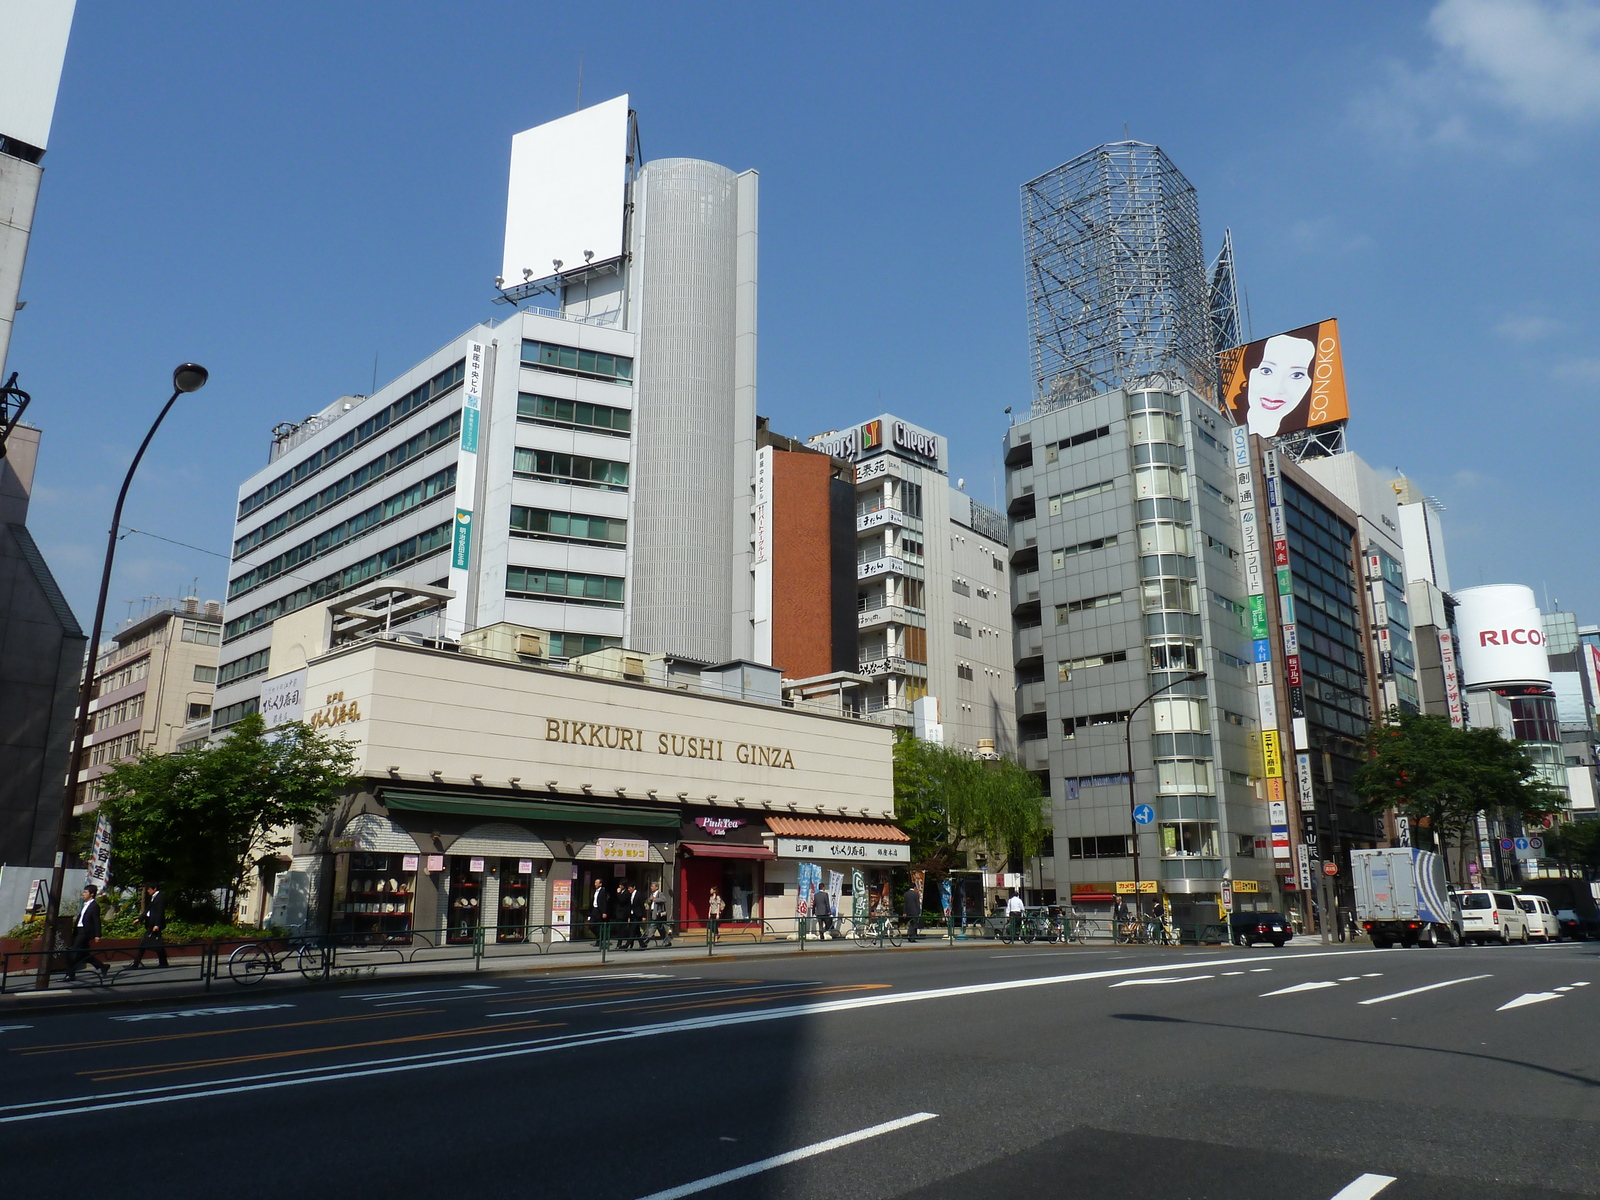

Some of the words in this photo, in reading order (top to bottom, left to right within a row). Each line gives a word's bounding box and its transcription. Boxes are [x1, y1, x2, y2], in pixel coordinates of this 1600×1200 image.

[470, 343, 482, 395] 銀座中央ビル
[1310, 337, 1336, 422] SONOKO
[893, 420, 938, 461] Cheers!
[1234, 428, 1247, 466] SOTSU
[1238, 472, 1253, 503] 創通
[262, 689, 300, 713] びっくり寿司
[1442, 647, 1462, 724] ニューギンザビル
[310, 700, 358, 731] びっくり寿司
[545, 718, 643, 752] BIKKURI
[658, 733, 723, 761] SUSHI
[736, 743, 796, 769] GINZA
[702, 816, 723, 828] Pink
[723, 818, 739, 828] Tea
[604, 848, 624, 857] タナカ
[795, 844, 814, 853] 江戸前
[830, 845, 866, 857] びっくり寿司
